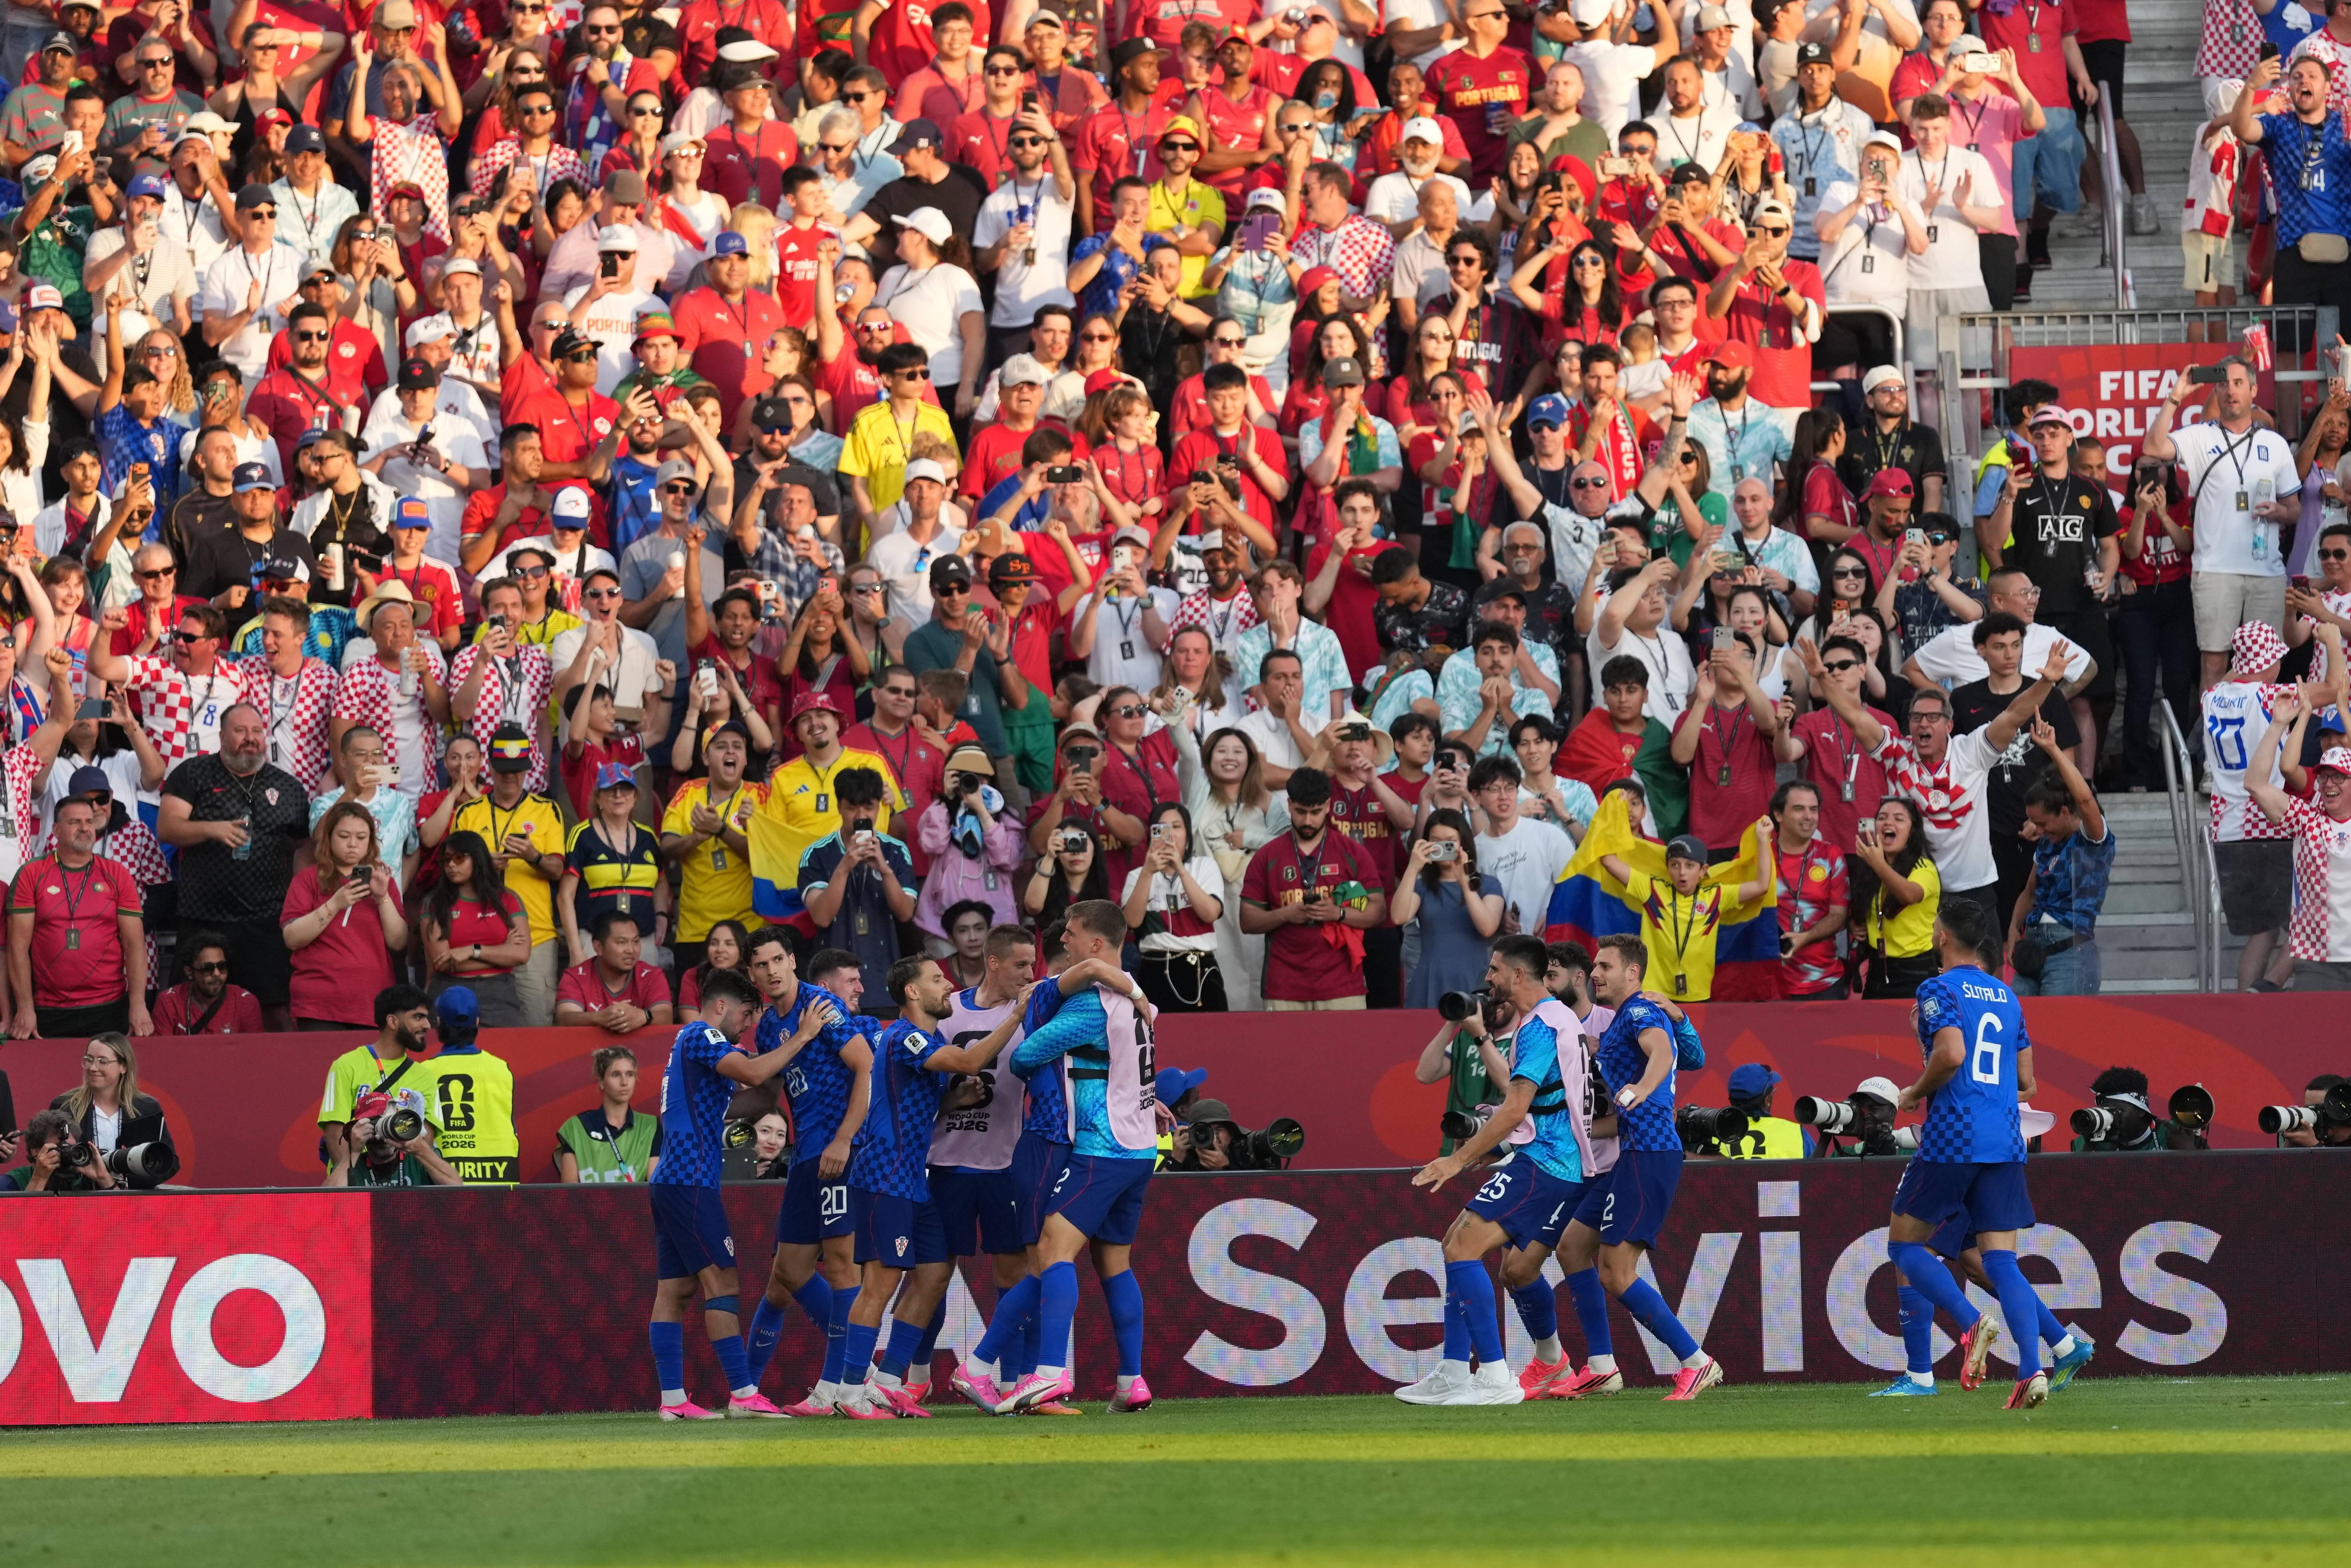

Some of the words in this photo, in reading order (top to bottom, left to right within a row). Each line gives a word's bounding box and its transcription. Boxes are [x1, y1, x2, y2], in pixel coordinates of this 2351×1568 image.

[1455, 84, 1521, 107] PORTUGAL
[587, 318, 637, 335] PORTUG
[1457, 341, 1502, 363] RTUGAL
[2100, 369, 2179, 401] FIFA
[2067, 405, 2173, 438] ORLD
[2042, 519, 2081, 538] AIG
[203, 704, 217, 727] 8
[2208, 714, 2247, 770] 10
[1972, 1012, 2003, 1085] 6
[1471, 1061, 1487, 1077] 14
[786, 1066, 809, 1099] 20
[442, 1140, 476, 1150] 2026
[452, 1162, 508, 1178] URITY
[1479, 1171, 1512, 1199] 25
[821, 1186, 847, 1215] 20
[1603, 1192, 1615, 1221] 2
